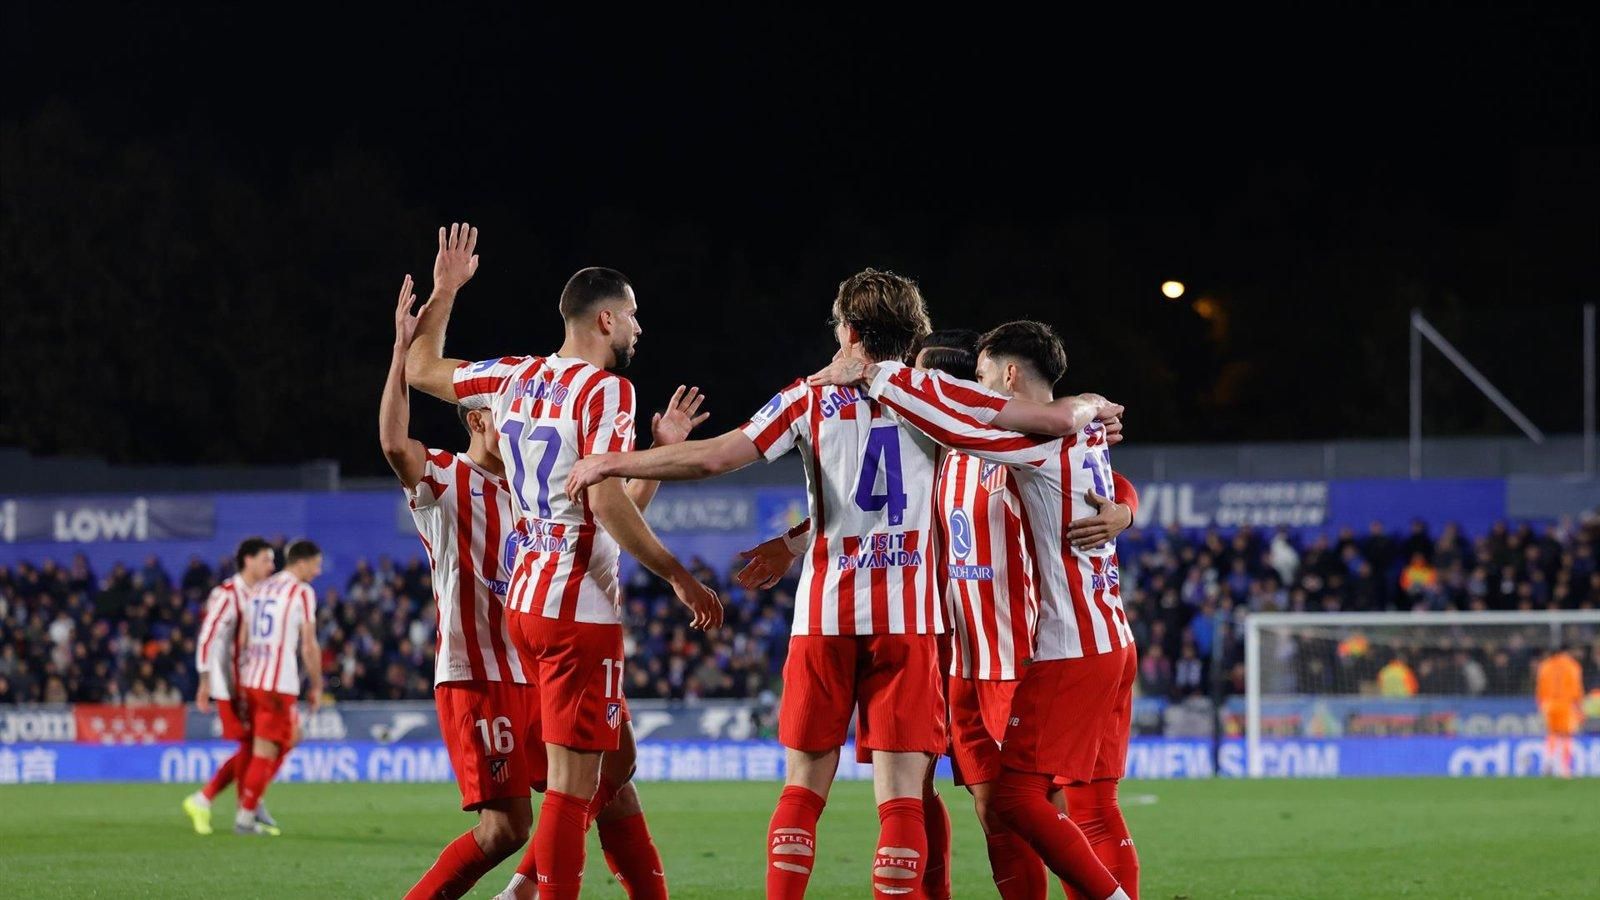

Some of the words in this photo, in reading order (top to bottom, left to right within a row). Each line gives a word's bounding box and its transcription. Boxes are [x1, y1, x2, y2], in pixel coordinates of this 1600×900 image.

[501, 418, 562, 519] 17
[855, 425, 908, 527] 4
[858, 533, 906, 551] VISIT
[837, 551, 922, 571] RWANDA
[950, 566, 969, 578] ADH
[971, 567, 991, 579] AIR
[252, 598, 277, 637] 15
[474, 715, 515, 756] 16
[772, 835, 814, 848] ATLETI
[873, 858, 917, 870] ATLETI
